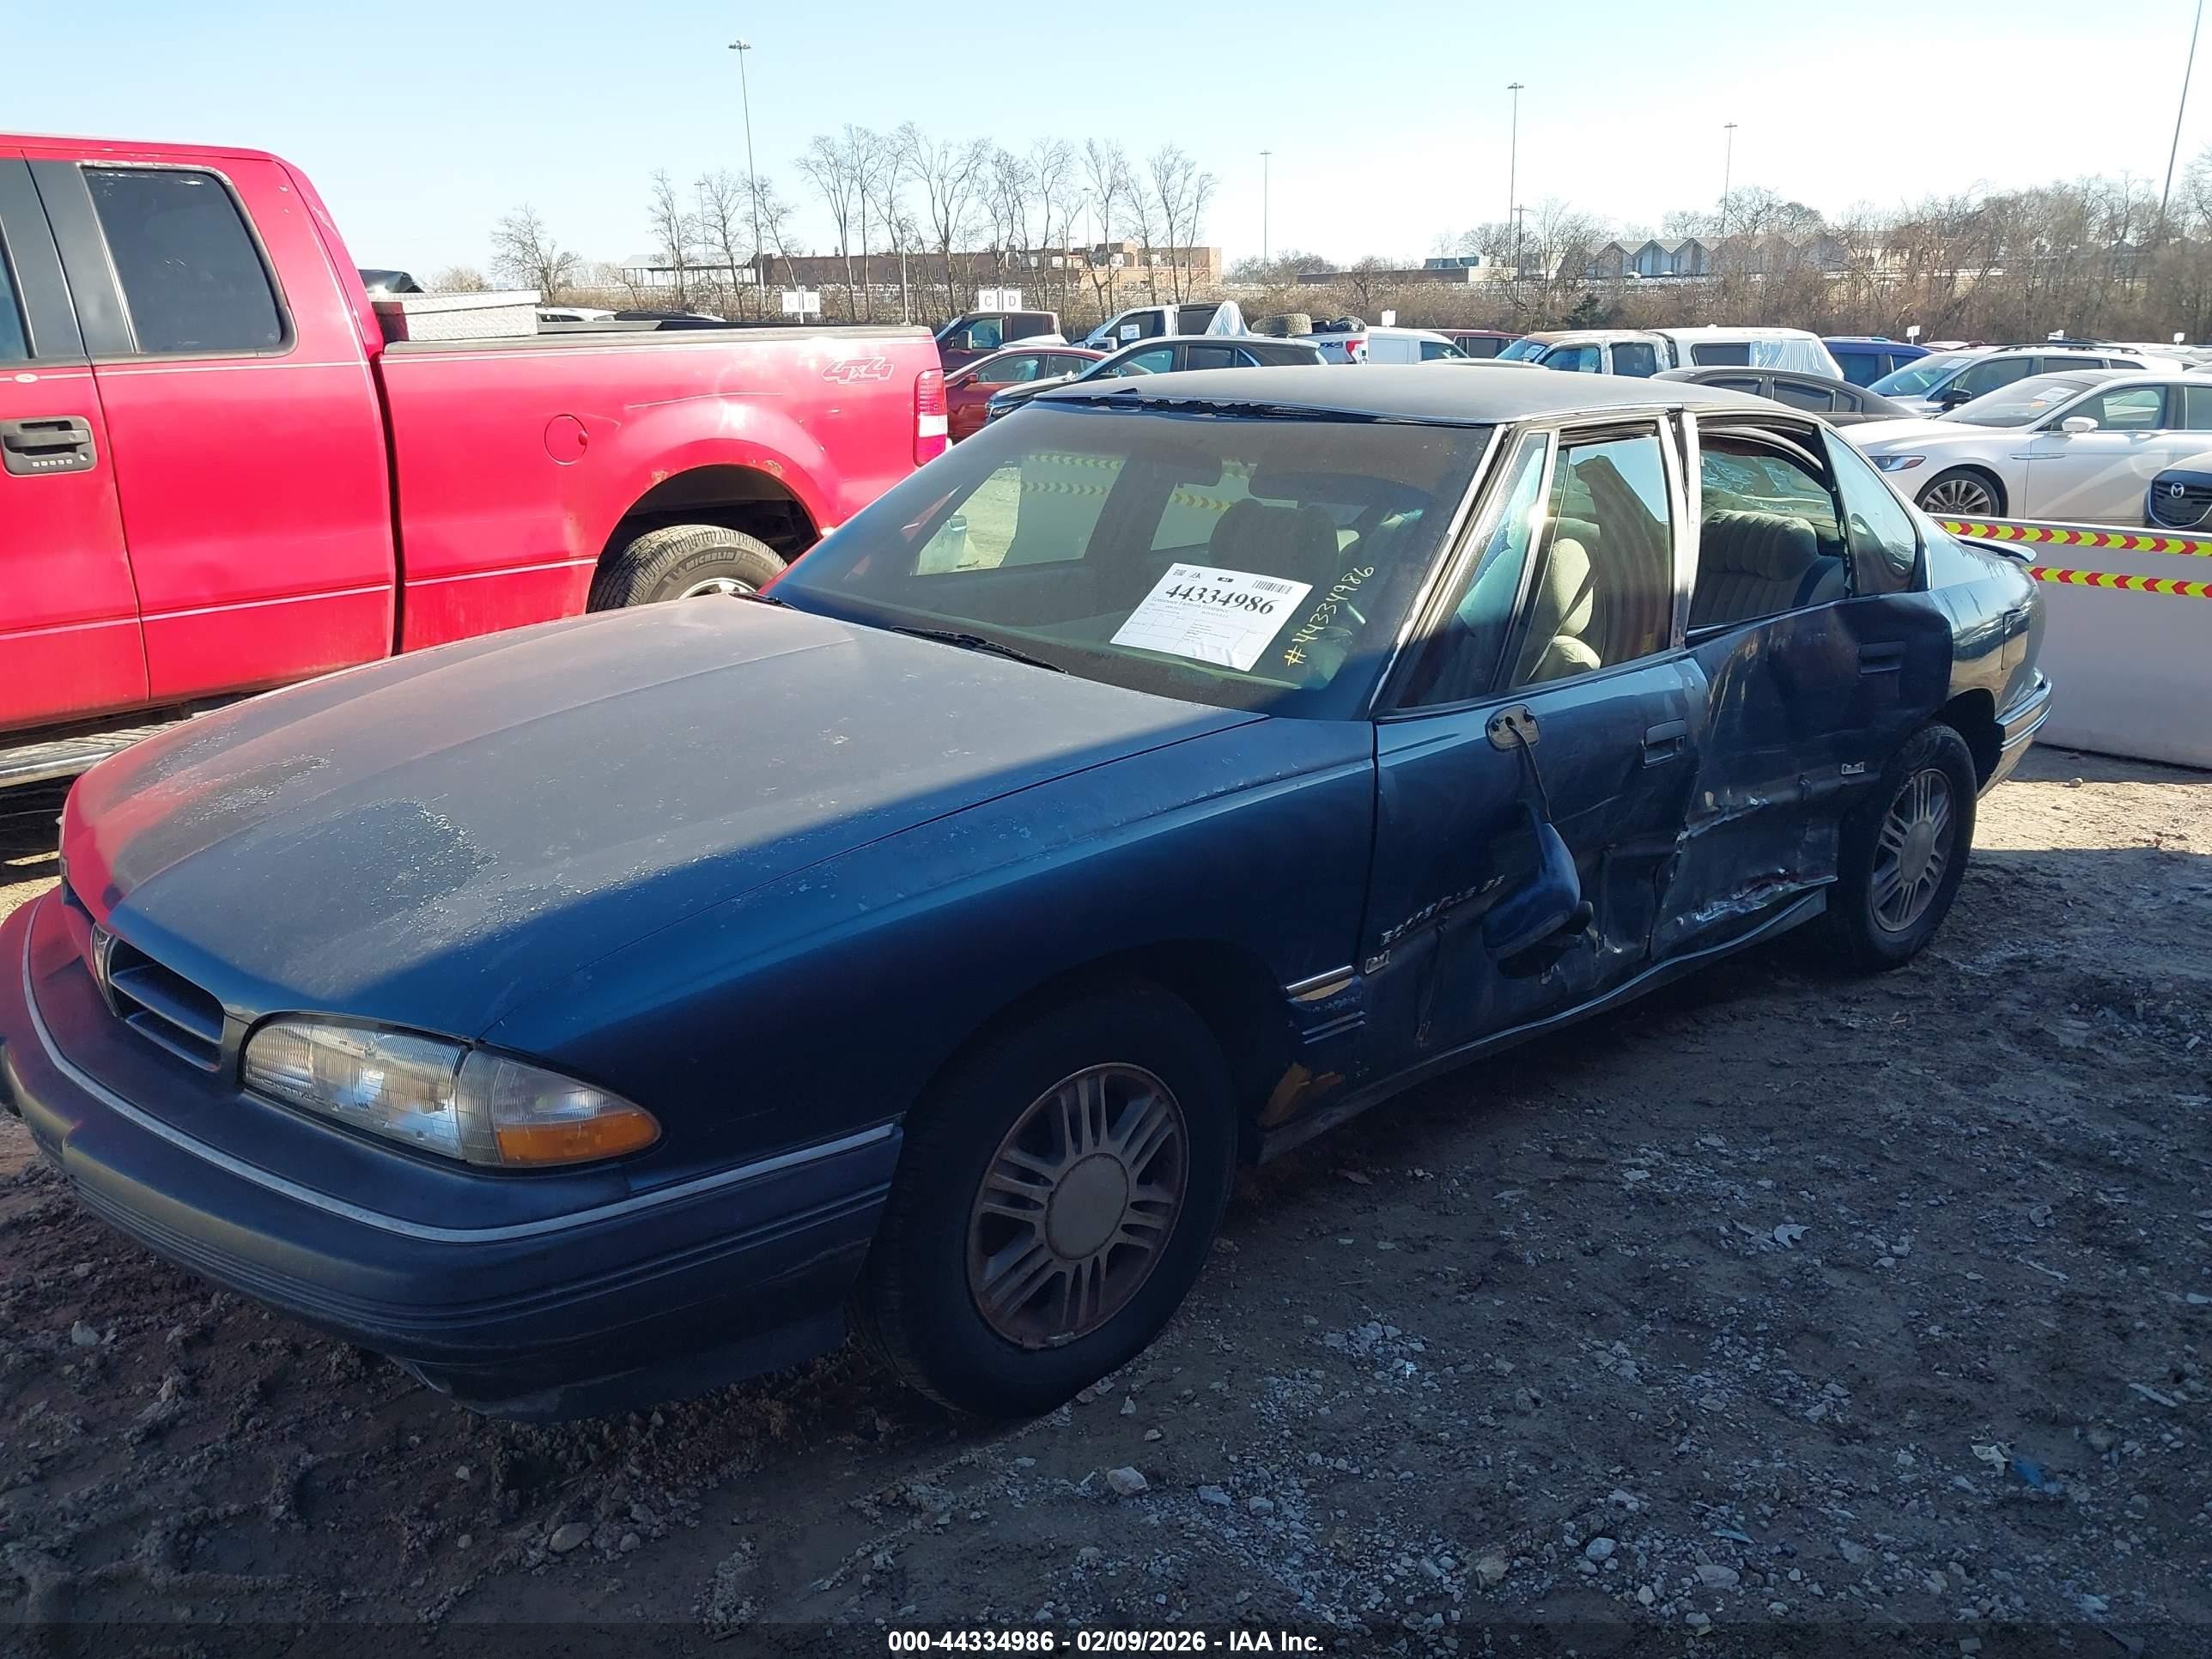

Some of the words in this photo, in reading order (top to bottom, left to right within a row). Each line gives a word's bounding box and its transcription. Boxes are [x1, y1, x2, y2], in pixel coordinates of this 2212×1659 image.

[984, 295, 993, 307] C
[1008, 295, 1017, 307] D
[685, 551, 735, 570] MICHELIN
[1165, 583, 1279, 615] 44334986
